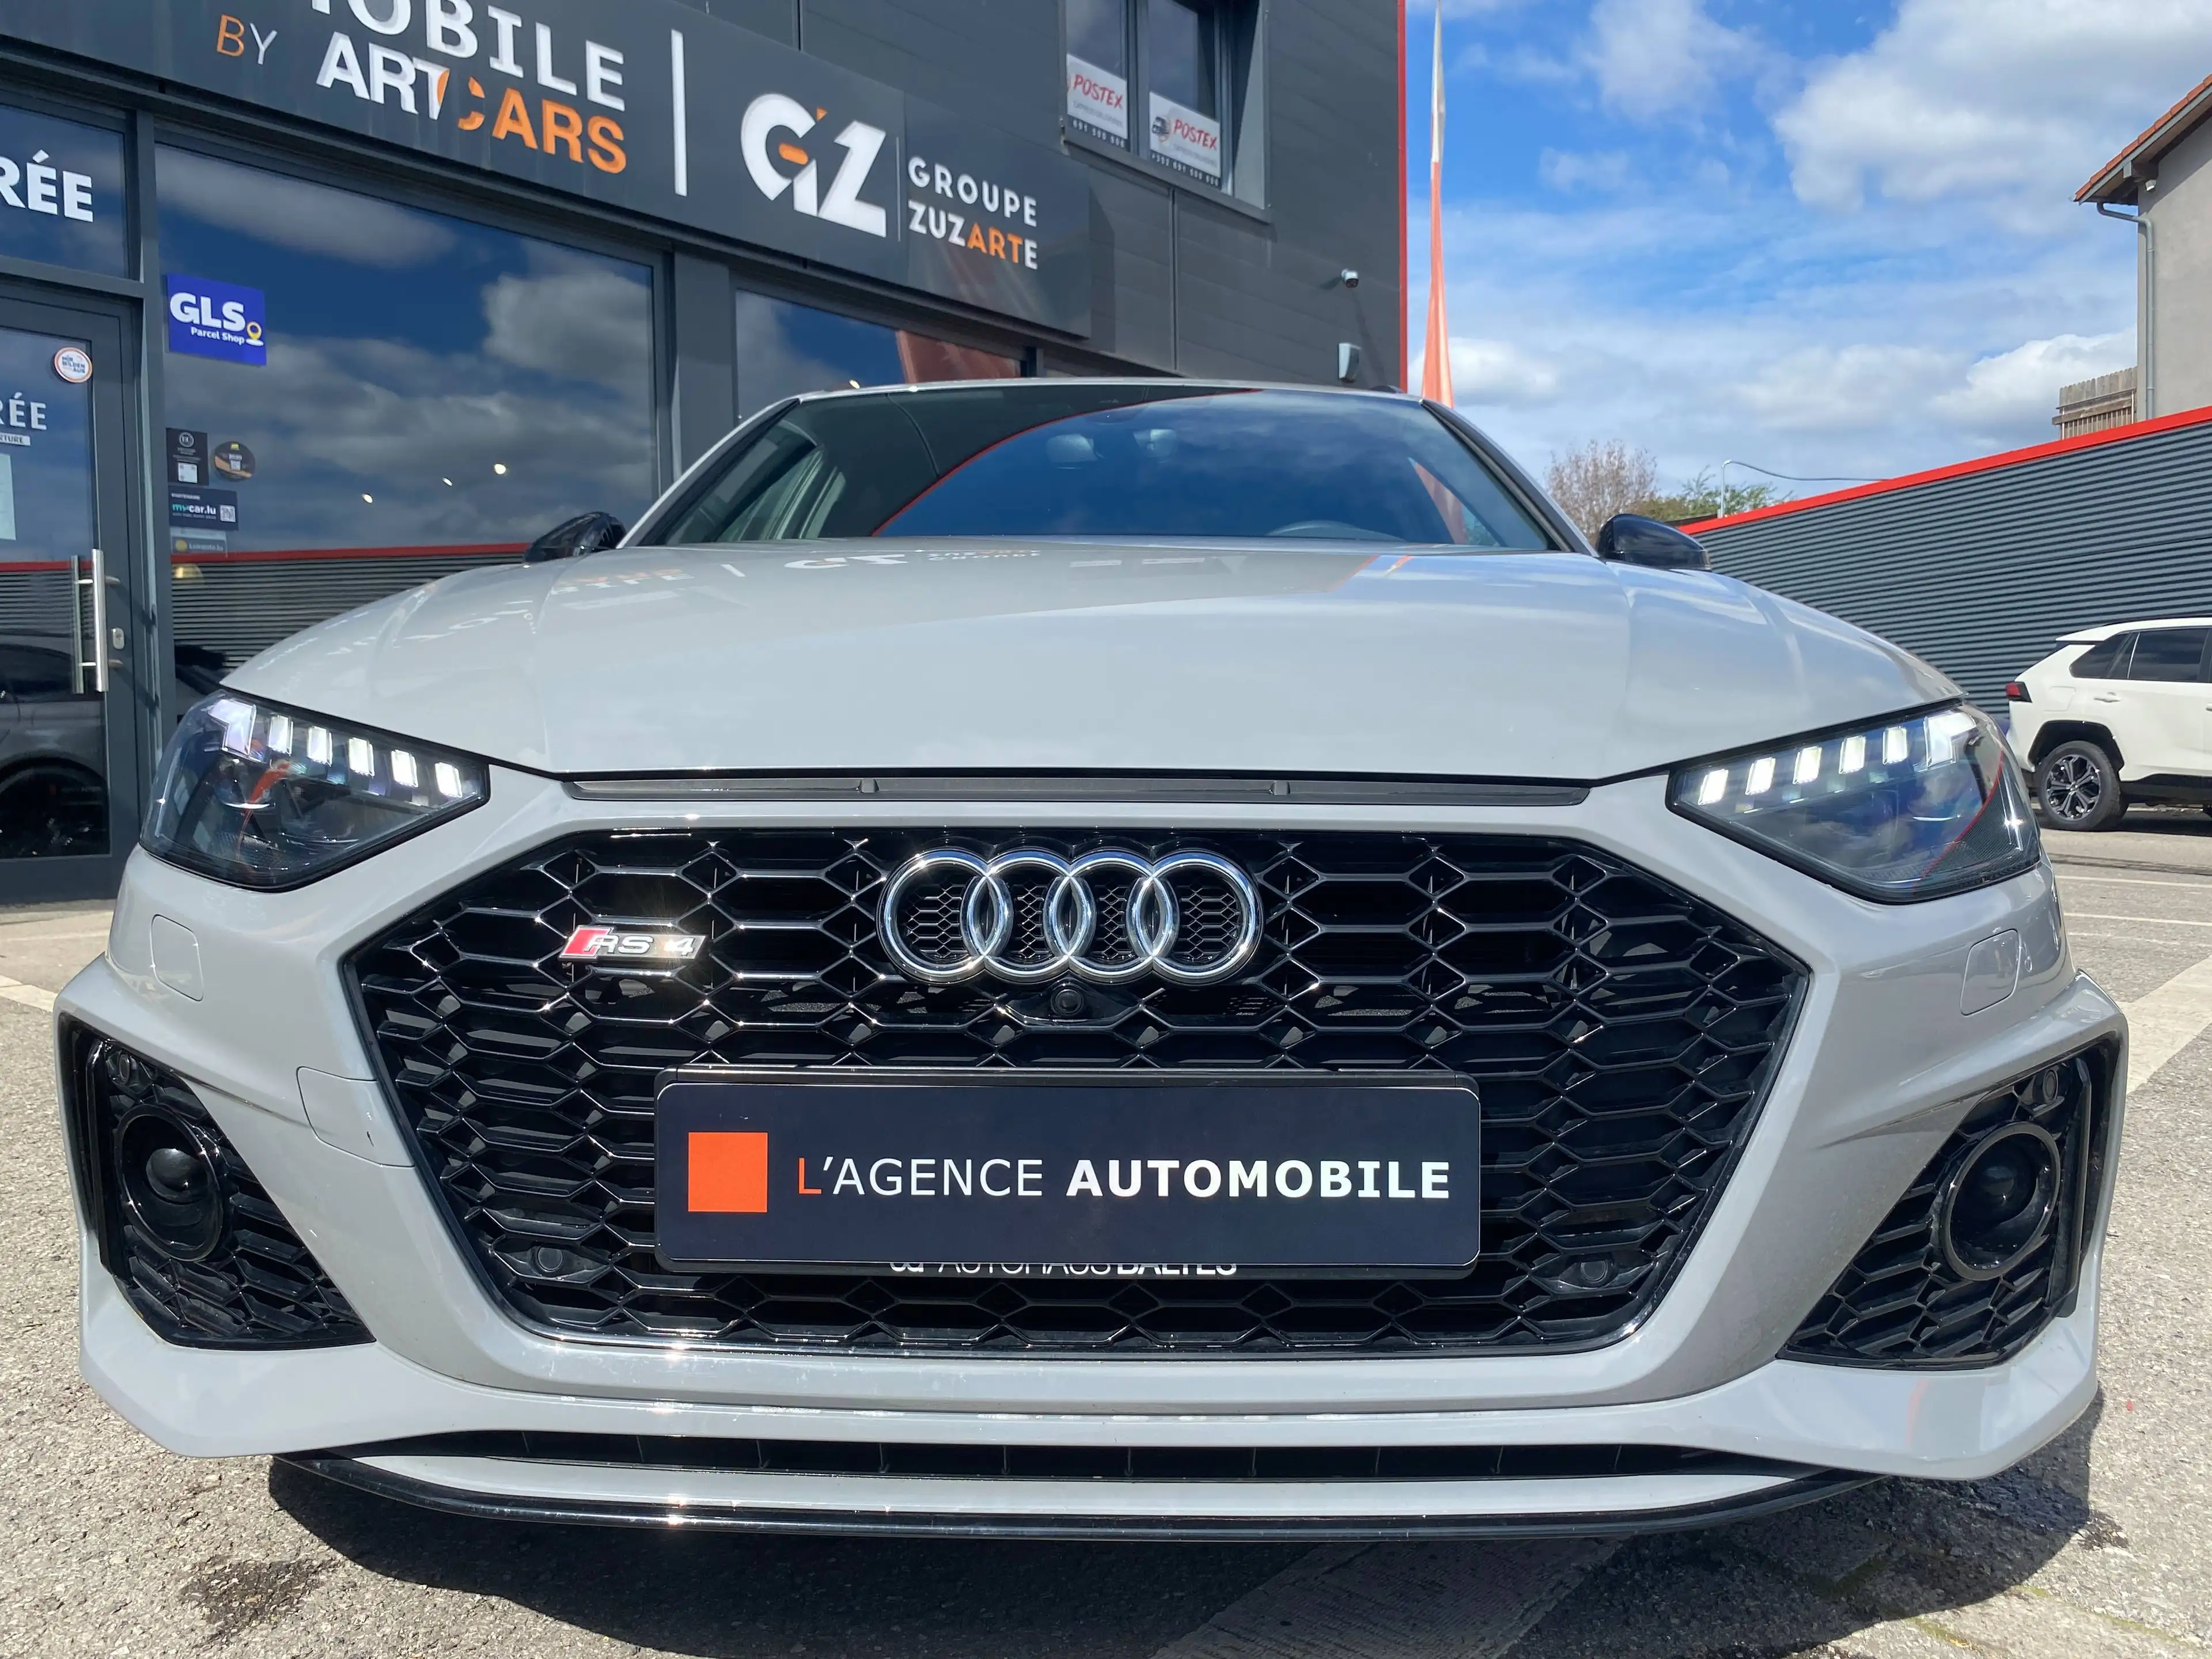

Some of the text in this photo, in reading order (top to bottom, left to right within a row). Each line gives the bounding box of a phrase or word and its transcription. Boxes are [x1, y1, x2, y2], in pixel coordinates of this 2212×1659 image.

[217, 14, 278, 65] BY
[1074, 74, 1123, 110] POSTEX
[1174, 119, 1217, 151] POSTEX
[908, 156, 1037, 227] GROUPE
[908, 199, 1037, 270] ZUZARTE
[170, 292, 246, 332] GLS
[191, 326, 245, 345] Parcel Shop
[0, 392, 47, 430] ÉE
[797, 1156, 1450, 1199] L'AGENCE AUTOMOBILE
